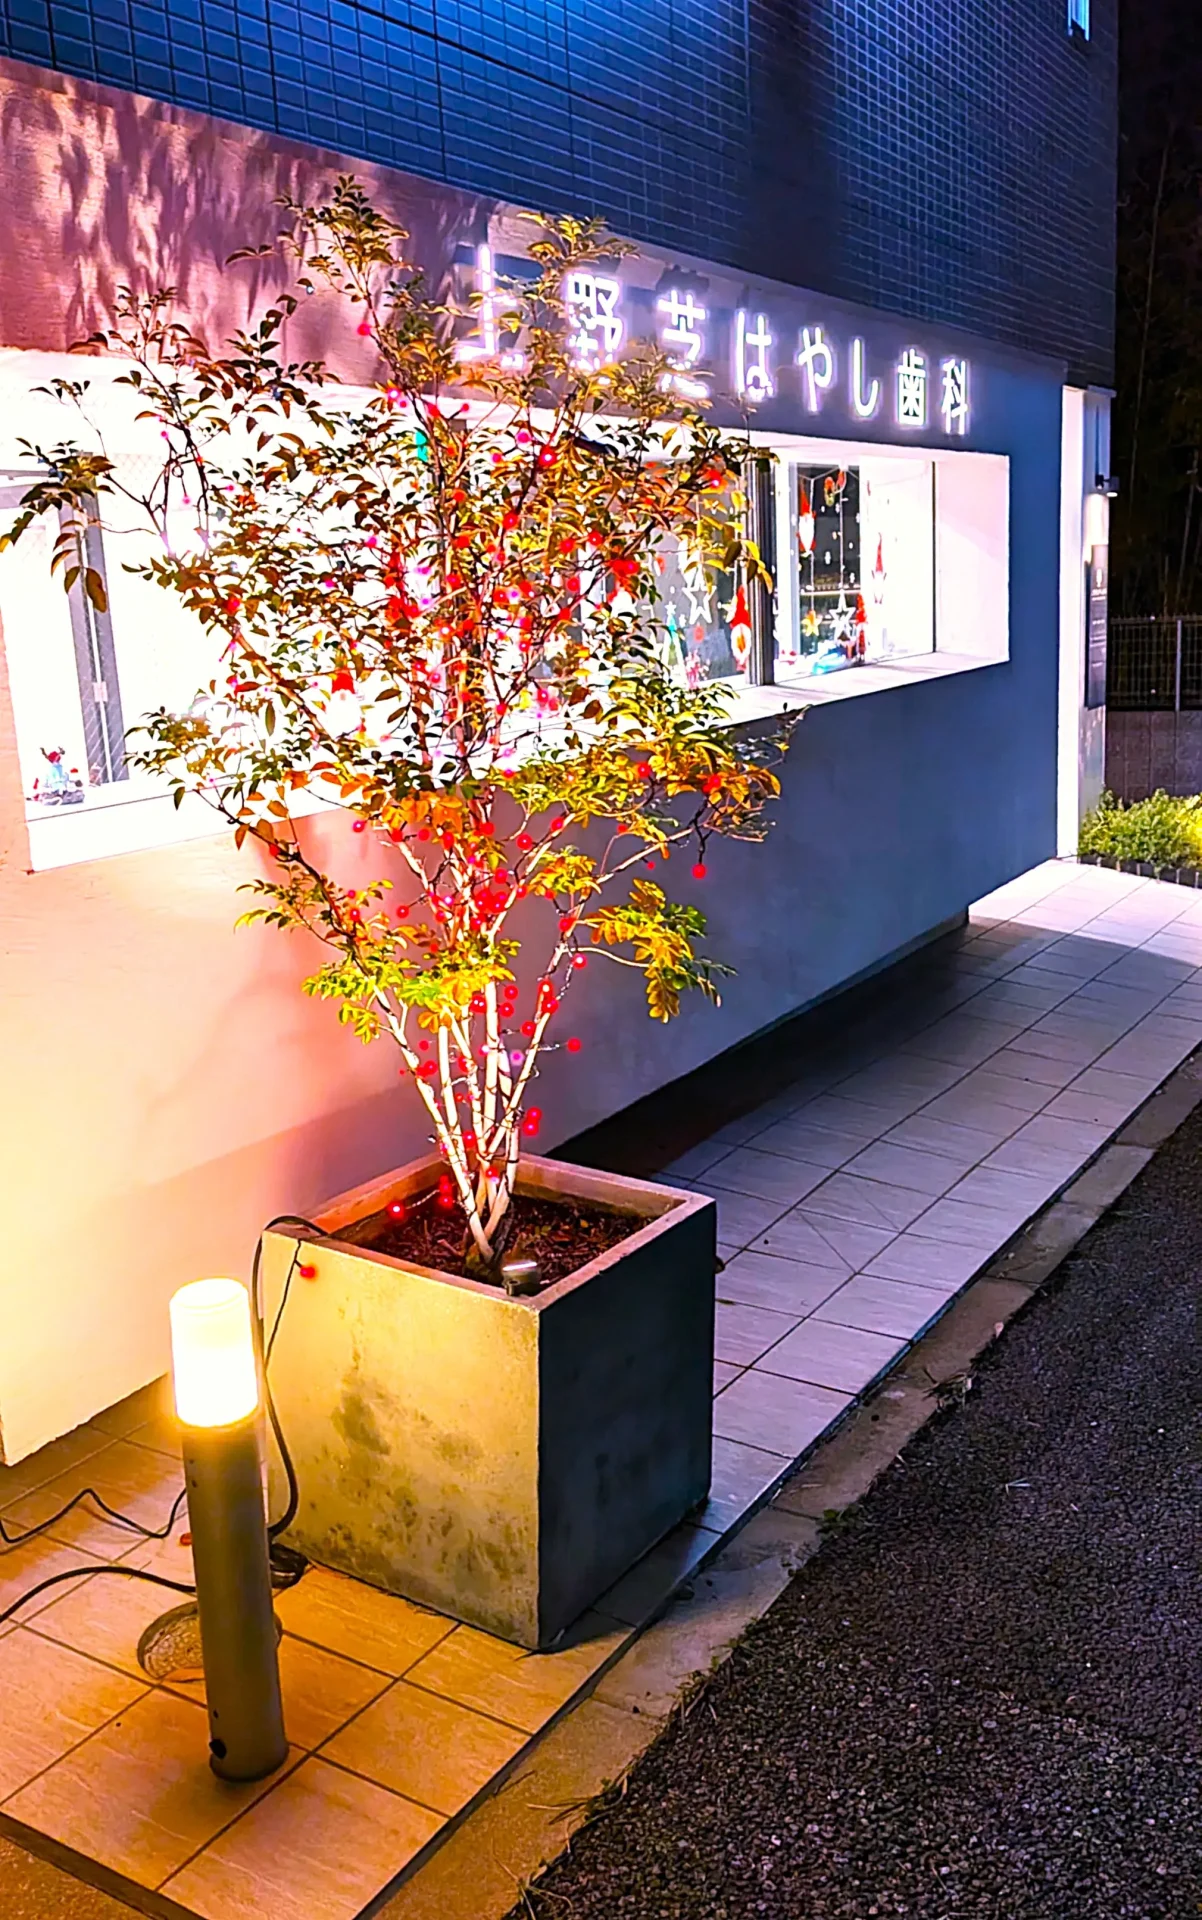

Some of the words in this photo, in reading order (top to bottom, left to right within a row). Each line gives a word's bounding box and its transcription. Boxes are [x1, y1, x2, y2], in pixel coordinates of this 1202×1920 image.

[456, 244, 970, 436] 上野芝はやし歯科
